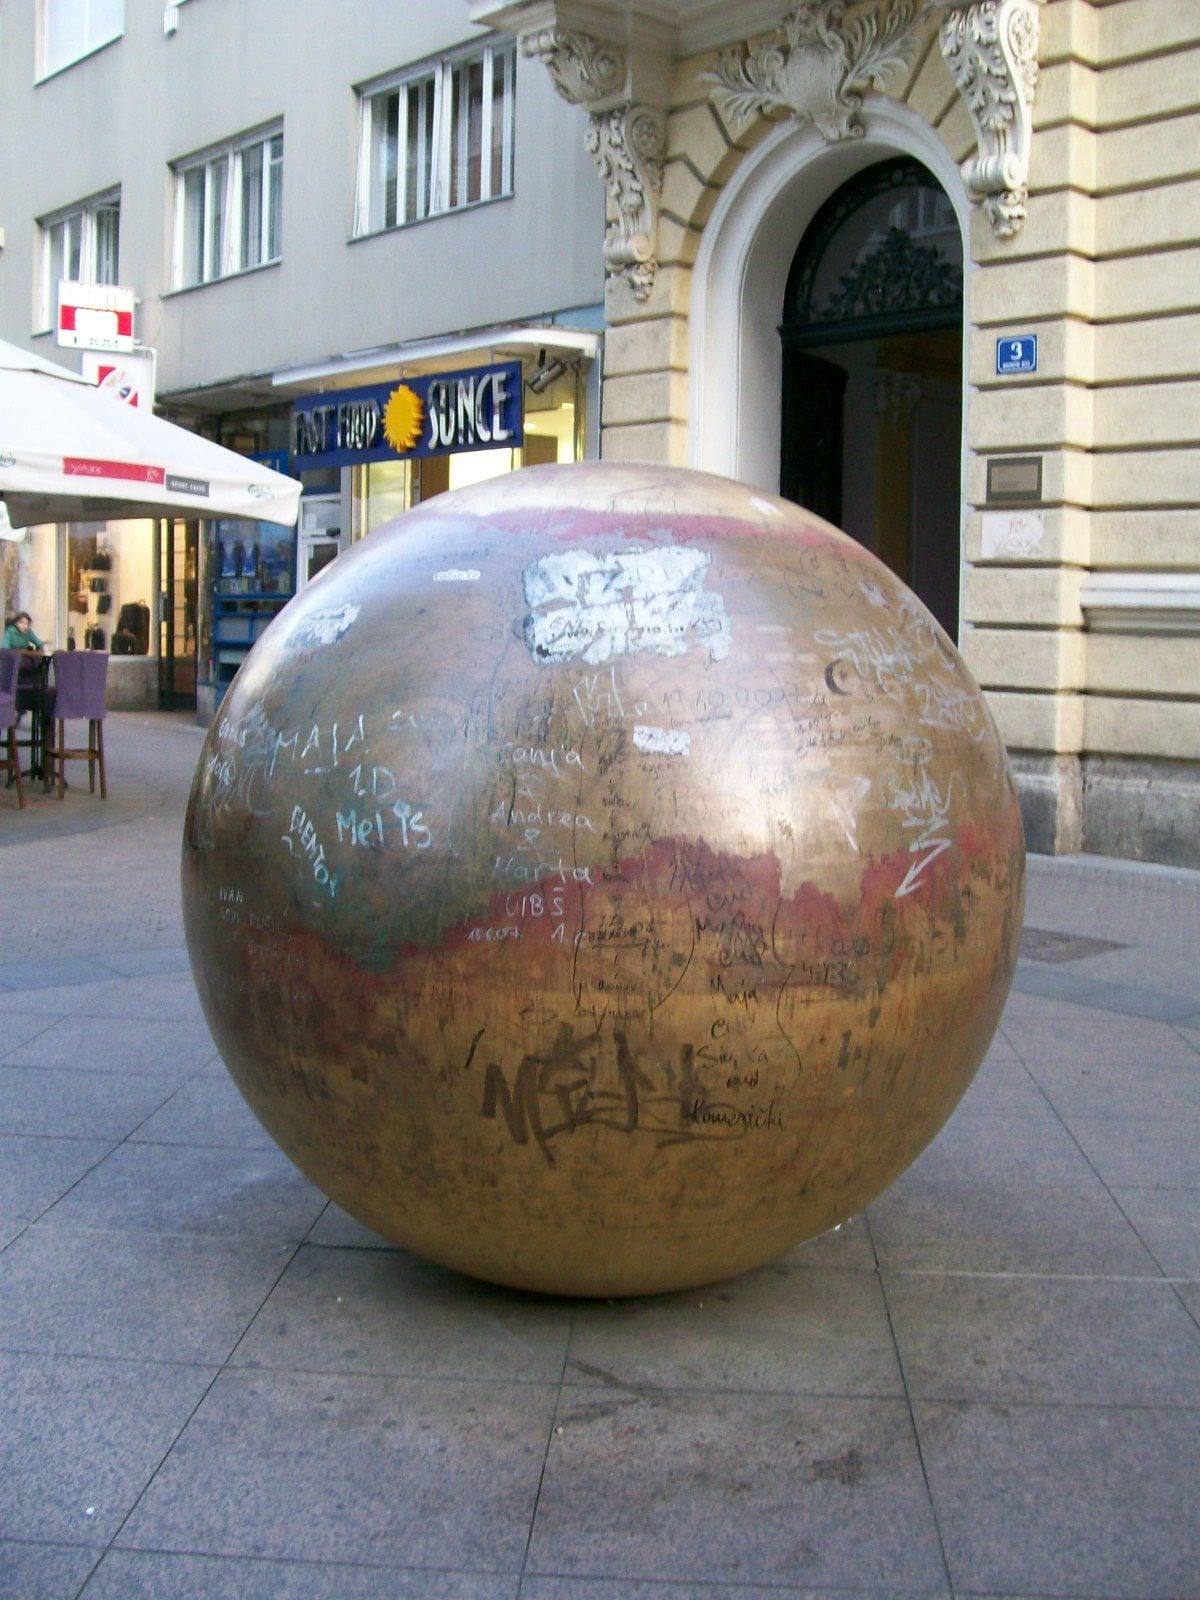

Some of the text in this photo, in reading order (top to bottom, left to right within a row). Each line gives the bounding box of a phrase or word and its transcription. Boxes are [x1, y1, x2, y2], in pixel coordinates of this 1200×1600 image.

[1010, 341, 1022, 360] 3
[337, 399, 379, 450] FOOD
[428, 371, 513, 449] SUNCE
